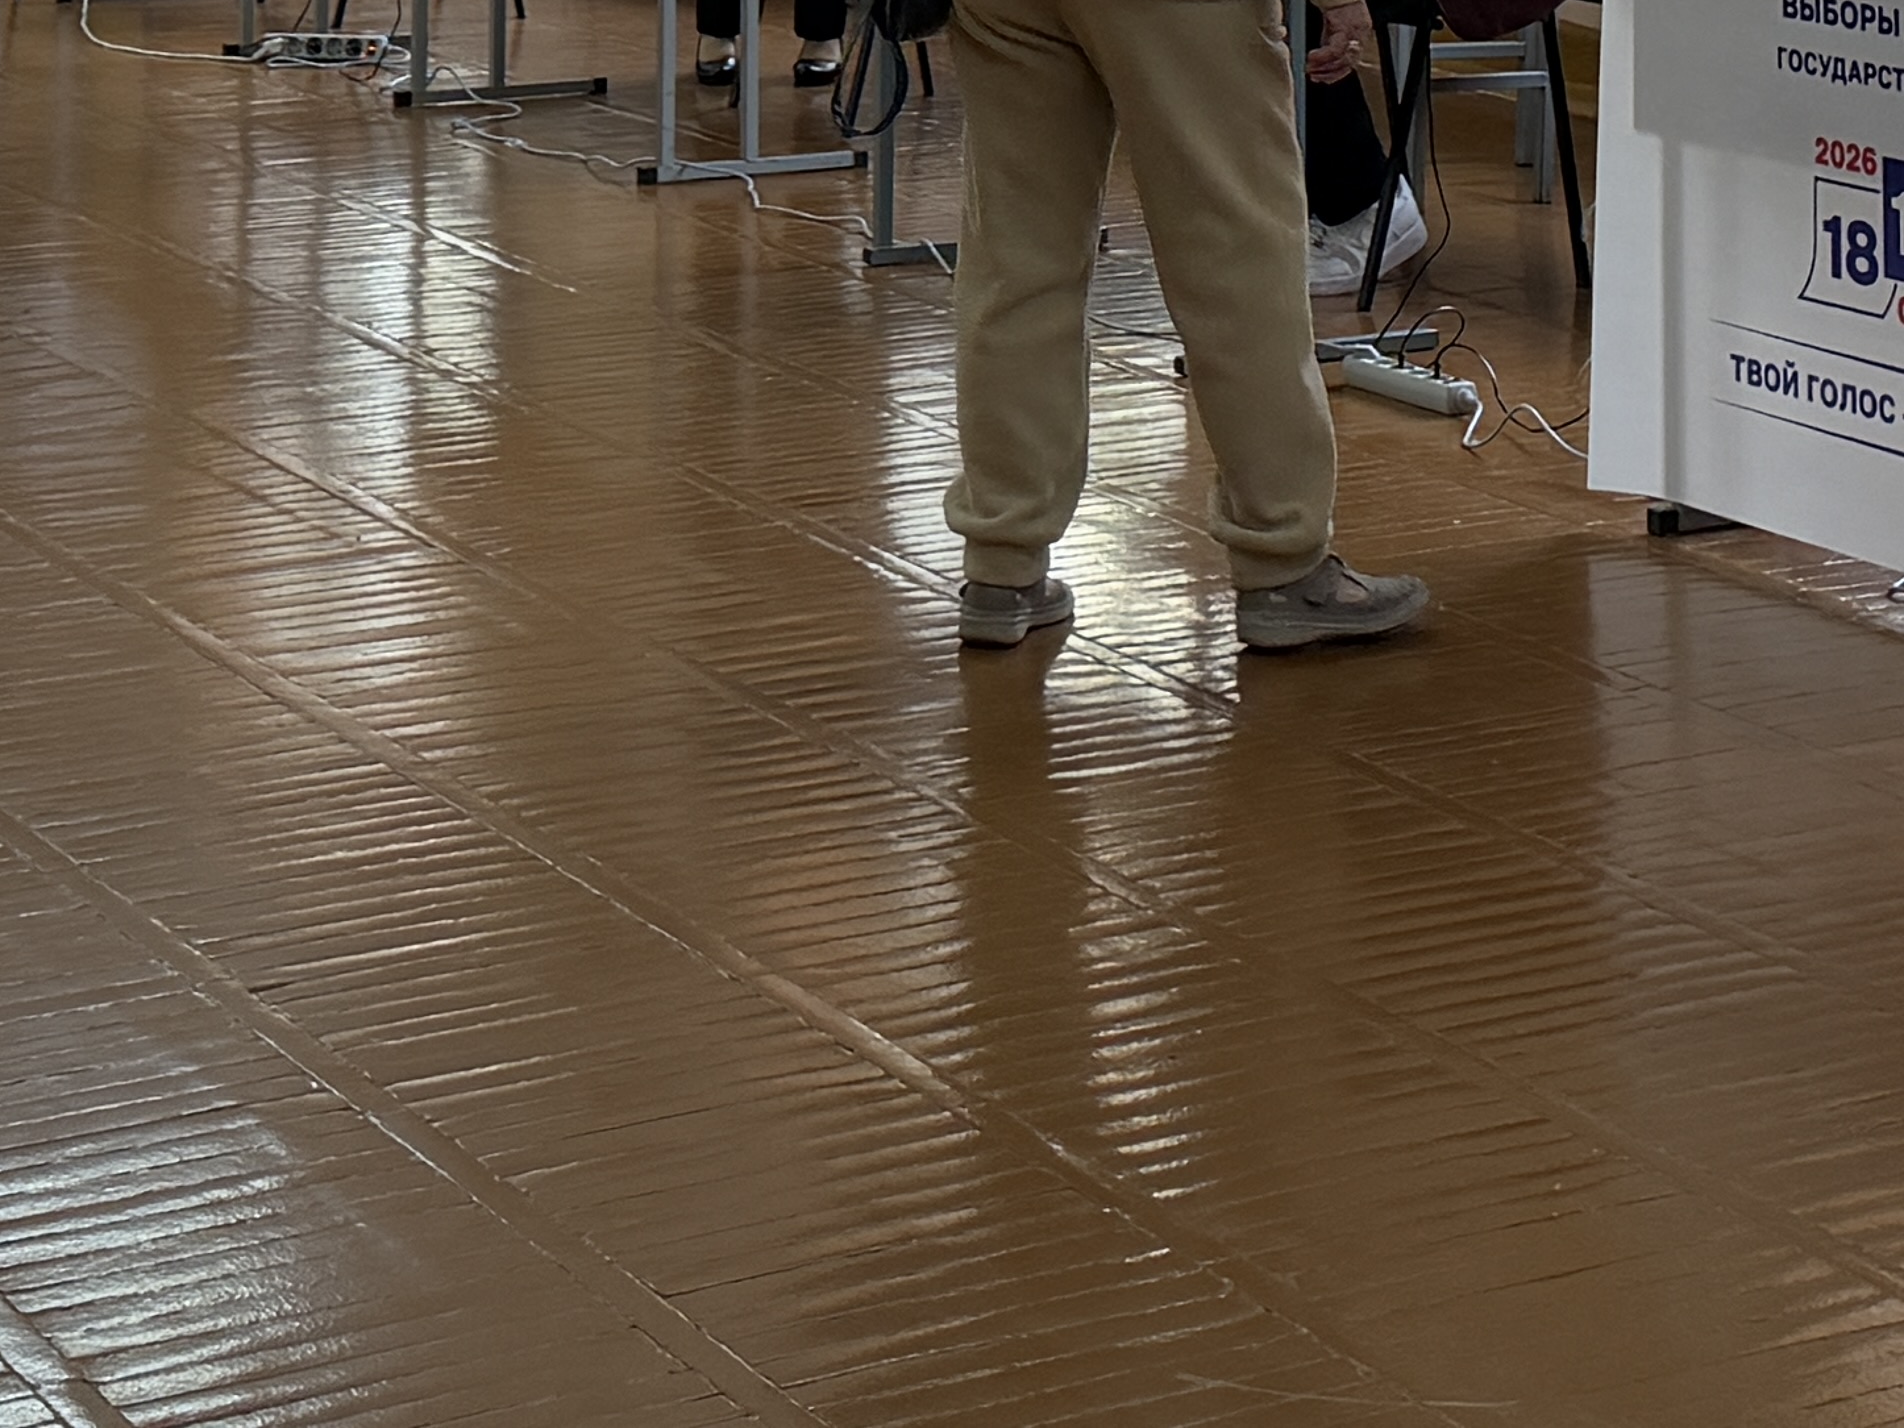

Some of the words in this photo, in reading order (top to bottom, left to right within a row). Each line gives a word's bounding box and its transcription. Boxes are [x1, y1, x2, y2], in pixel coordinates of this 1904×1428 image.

[1815, 137, 1877, 176] 2026
[1822, 215, 1879, 286] 18
[1729, 352, 1798, 399] ТВОЙ
[1806, 373, 1896, 424] ГОЛОС
